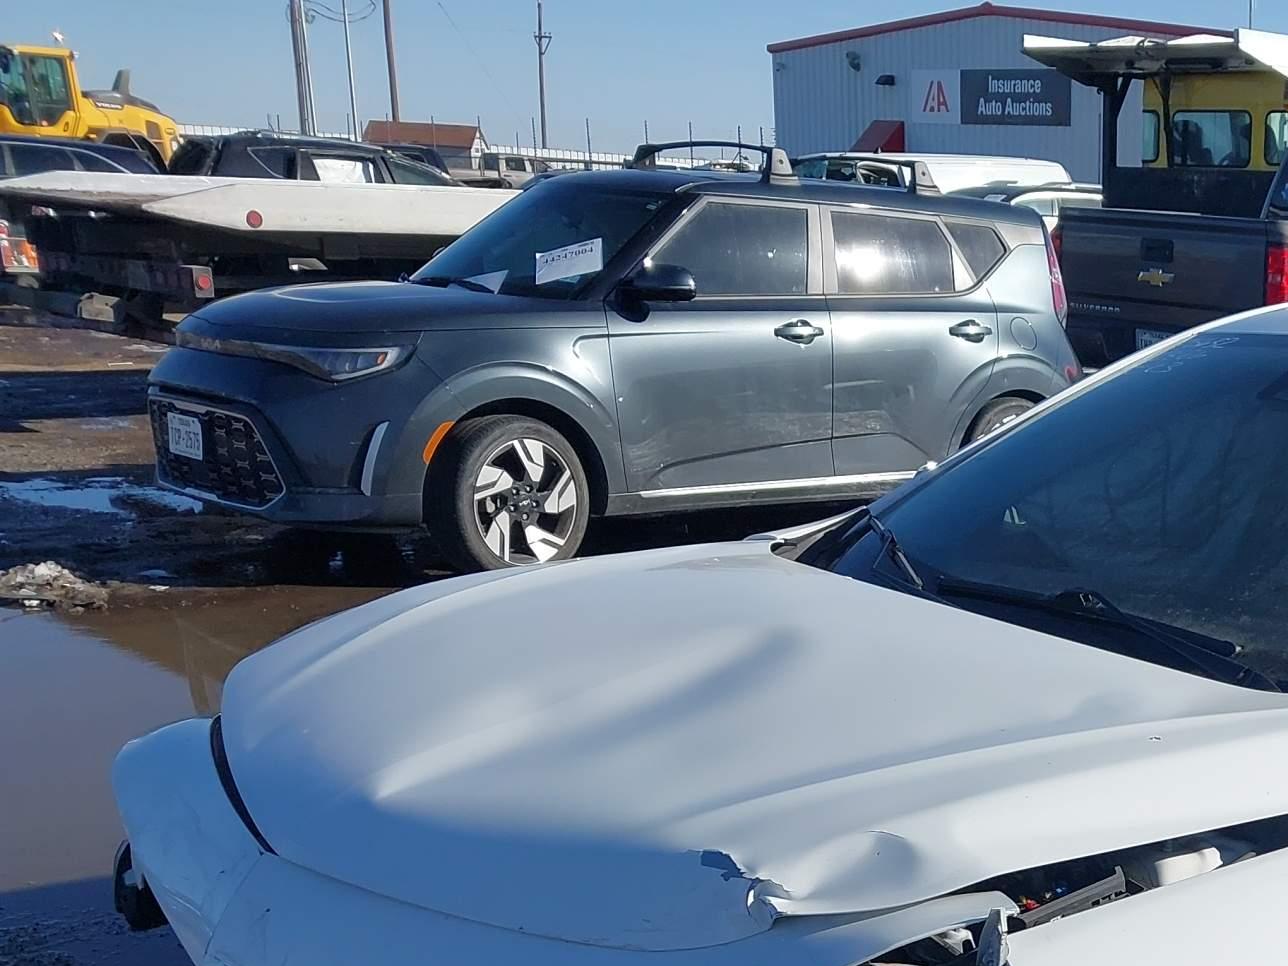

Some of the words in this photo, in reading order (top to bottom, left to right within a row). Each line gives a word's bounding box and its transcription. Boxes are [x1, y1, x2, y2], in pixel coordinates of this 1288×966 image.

[988, 75, 1041, 93] Insurance
[977, 98, 1001, 116] Auto
[1004, 97, 1052, 116] Auctions
